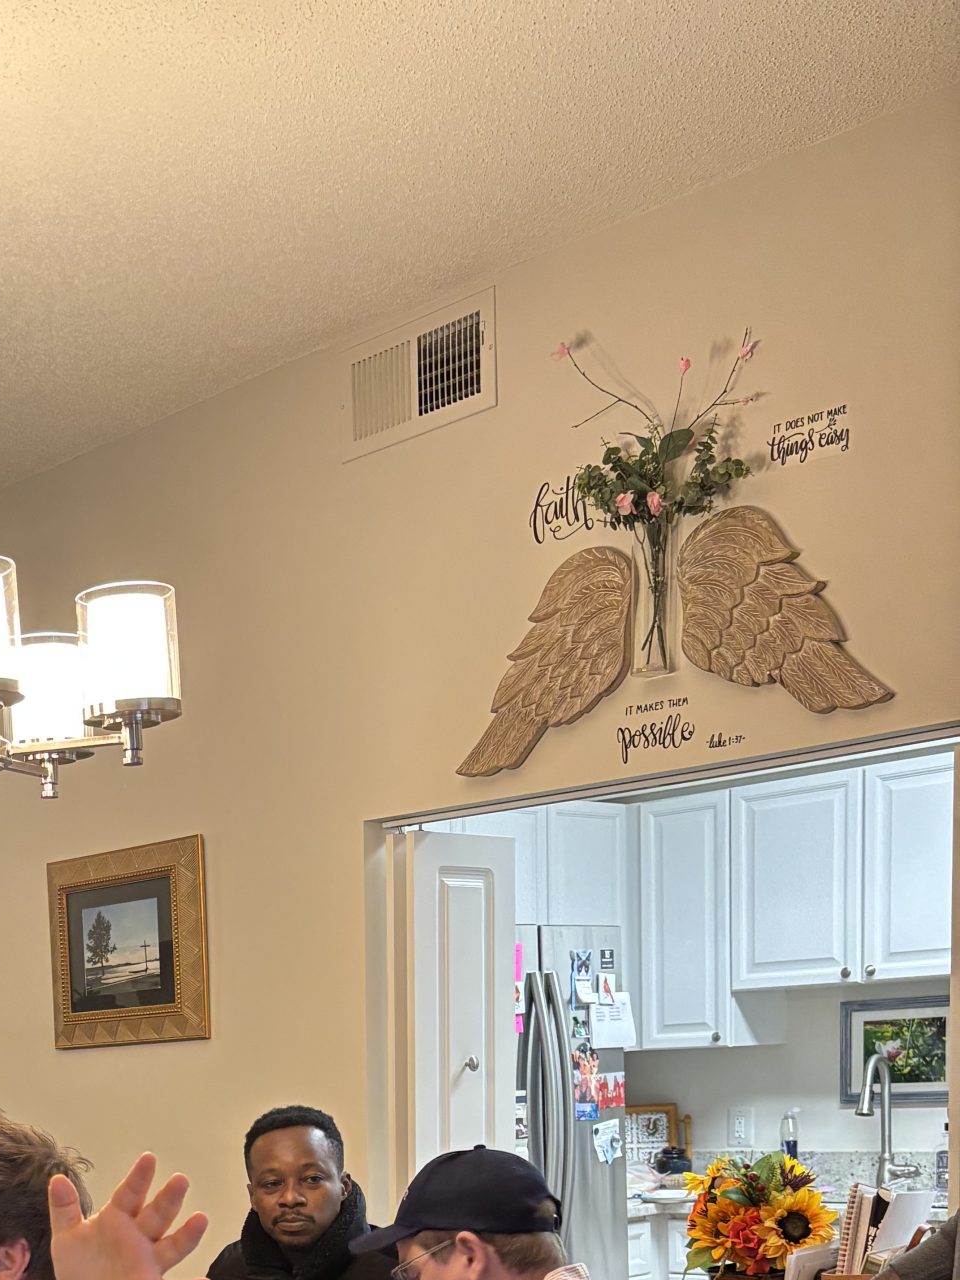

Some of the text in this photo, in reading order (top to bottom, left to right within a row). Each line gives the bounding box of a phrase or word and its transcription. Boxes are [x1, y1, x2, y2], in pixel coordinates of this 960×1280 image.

[773, 404, 848, 435] IT DOES NOT MAKE
[767, 428, 850, 466] things easy
[529, 473, 594, 545] faith
[625, 697, 689, 716] IT MAKES THEM
[617, 713, 695, 765] possible
